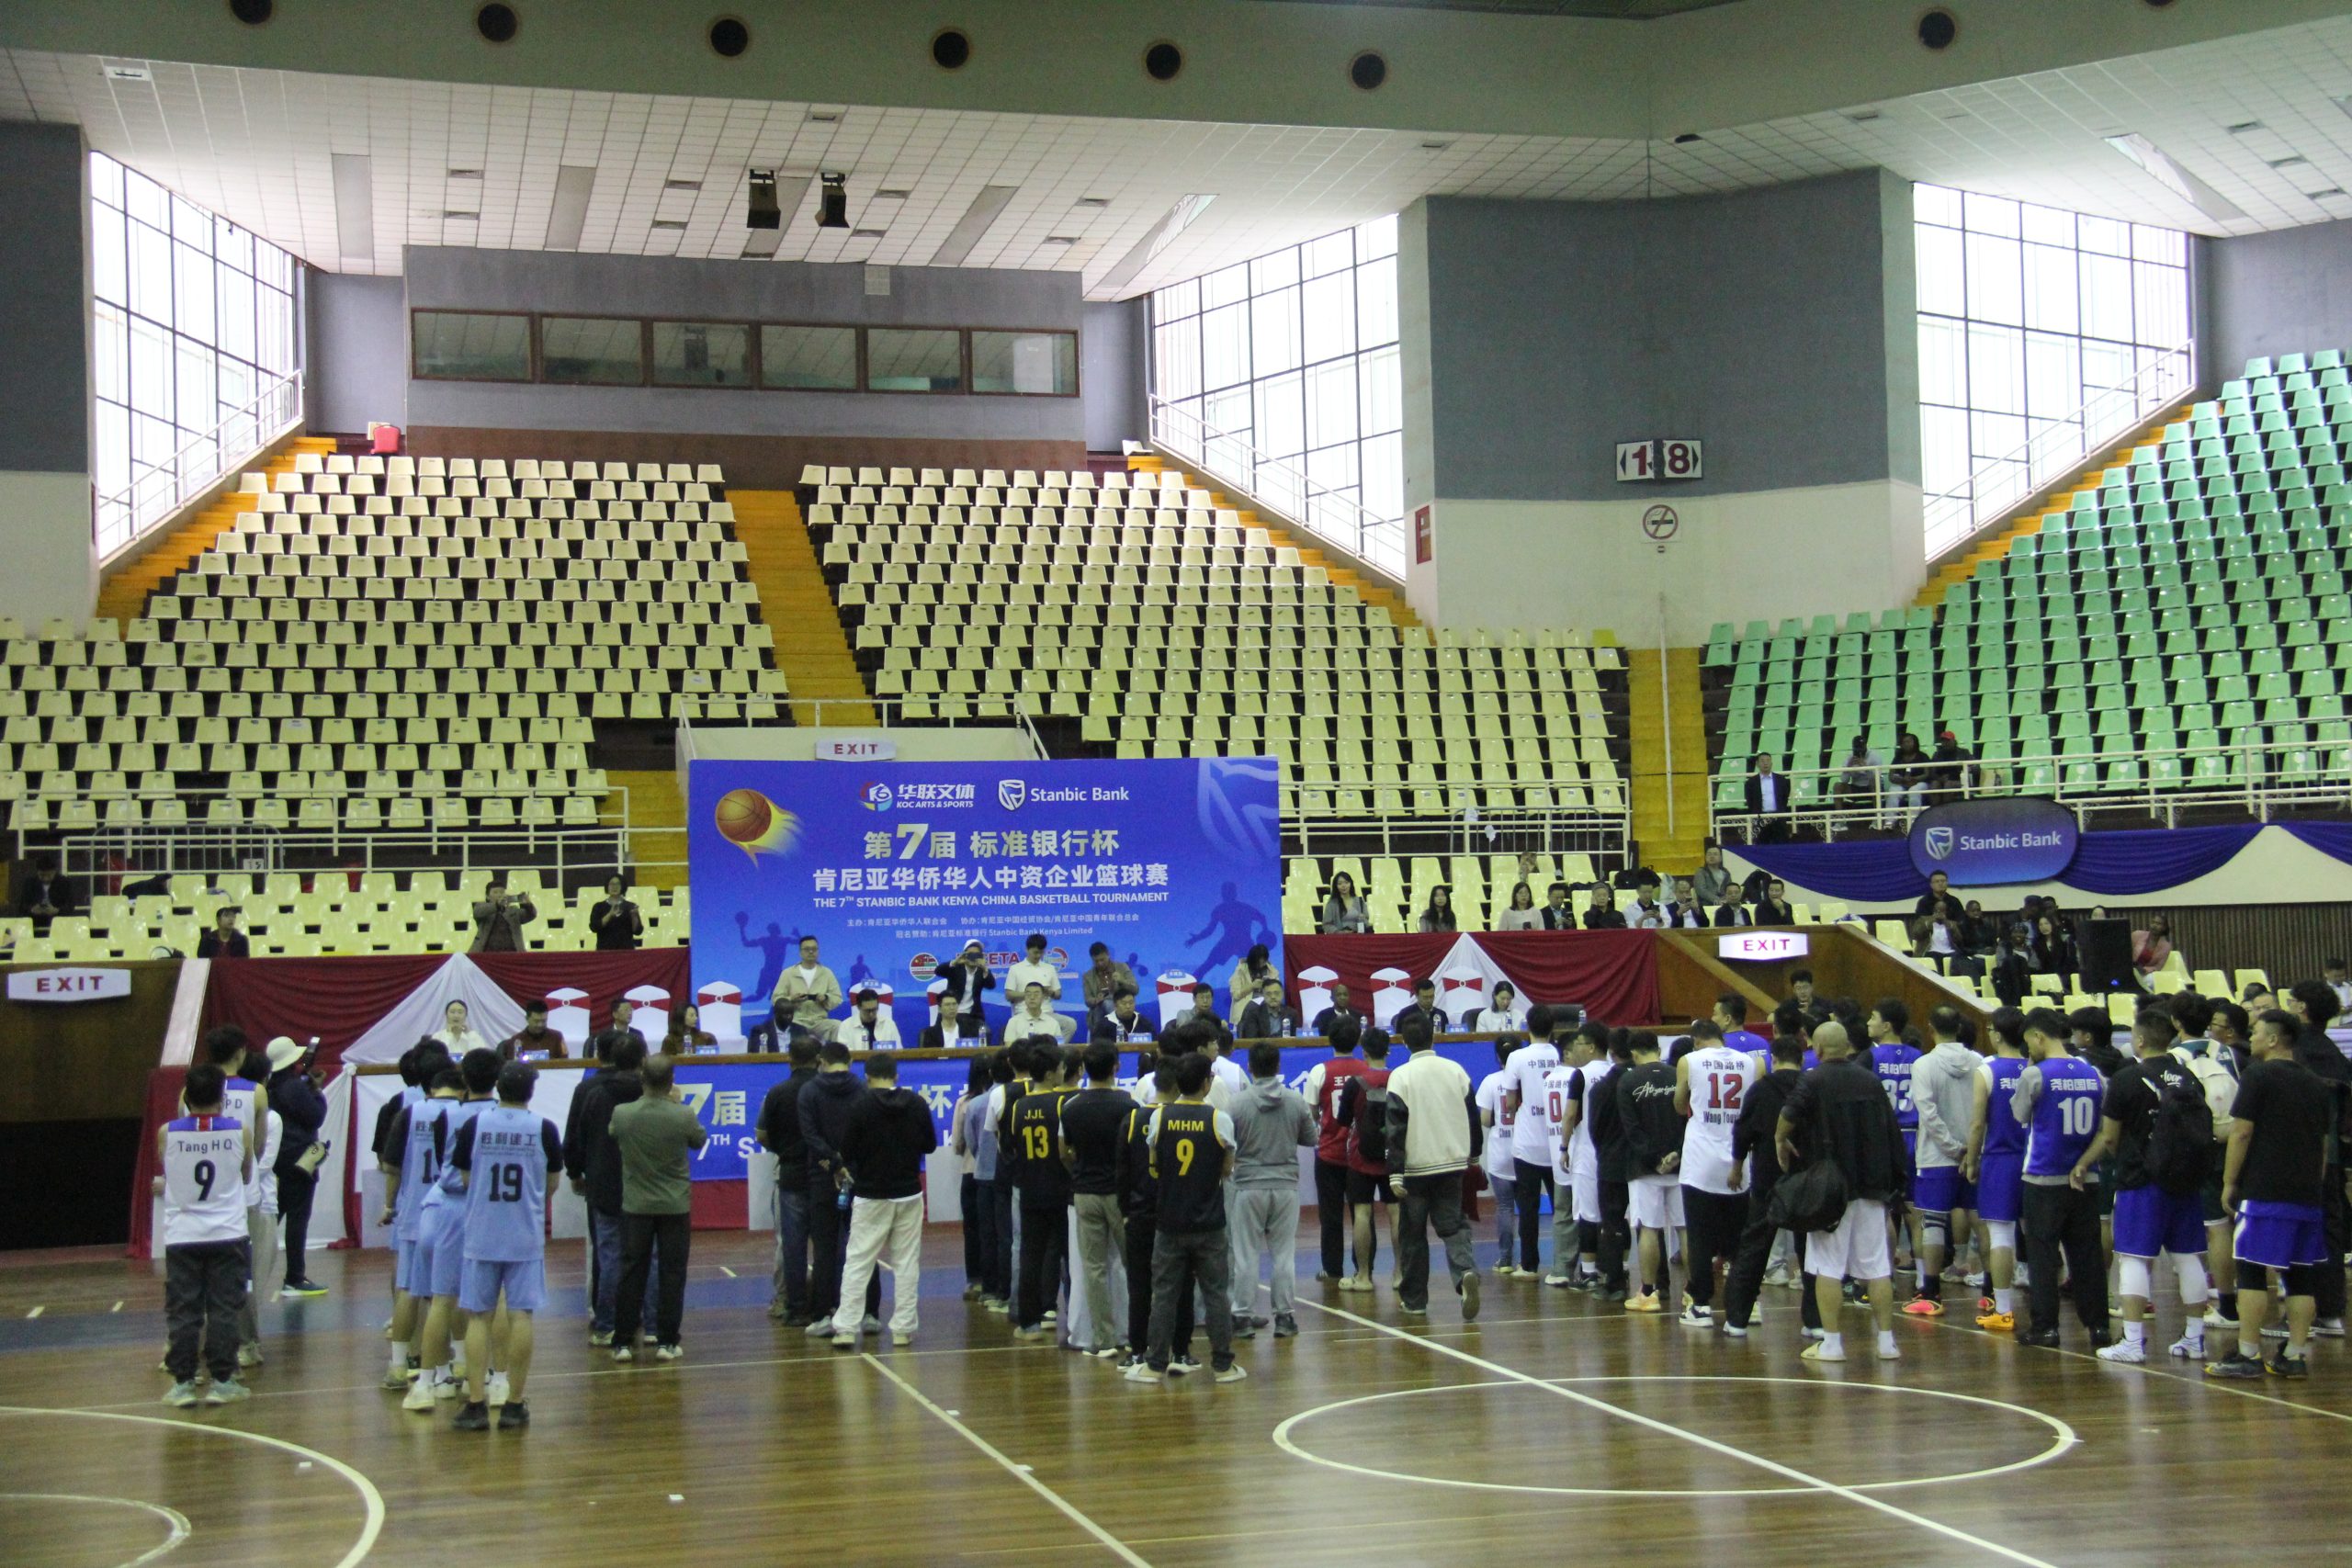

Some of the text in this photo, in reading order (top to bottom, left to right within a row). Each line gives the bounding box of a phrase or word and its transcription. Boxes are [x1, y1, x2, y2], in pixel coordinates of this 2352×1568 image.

[1632, 445, 1647, 476] 1
[1668, 443, 1690, 475] 8
[834, 743, 879, 755] EXIT
[897, 784, 976, 800] 华联文体
[1030, 786, 1129, 802] Stanbic Bank
[943, 800, 974, 808] SPORTS
[863, 823, 1120, 860] 第7届 标准银行杯
[1960, 830, 2062, 851] Stanbic Bank
[812, 863, 1169, 892] 肯尼亚华侨华人中资企业篮球赛
[813, 897, 836, 908] THE
[856, 897, 905, 907] STANBIC
[908, 896, 939, 906] BANK
[942, 895, 979, 906] KENYA
[981, 894, 1017, 905] CHINA
[1019, 893, 1091, 904] BASKETBALL
[1091, 892, 1170, 903] TOURNAMENT
[1039, 928, 1063, 937] Kenya
[1063, 927, 1092, 935] Limited
[1743, 939, 1791, 952] EXIT
[37, 976, 104, 993] EXIT
[1879, 1062, 1913, 1075] 尧柏国
[1707, 1072, 1743, 1109] 12
[1023, 1108, 1045, 1120] JJL
[1703, 1111, 1722, 1125] Wang
[2058, 1096, 2095, 1135] 10
[1167, 1119, 1204, 1133] MHM
[177, 1140, 209, 1154] Tang
[1022, 1125, 1049, 1160] 13
[1175, 1138, 1194, 1177] 9
[194, 1159, 216, 1201] 9
[489, 1162, 524, 1202] 19
